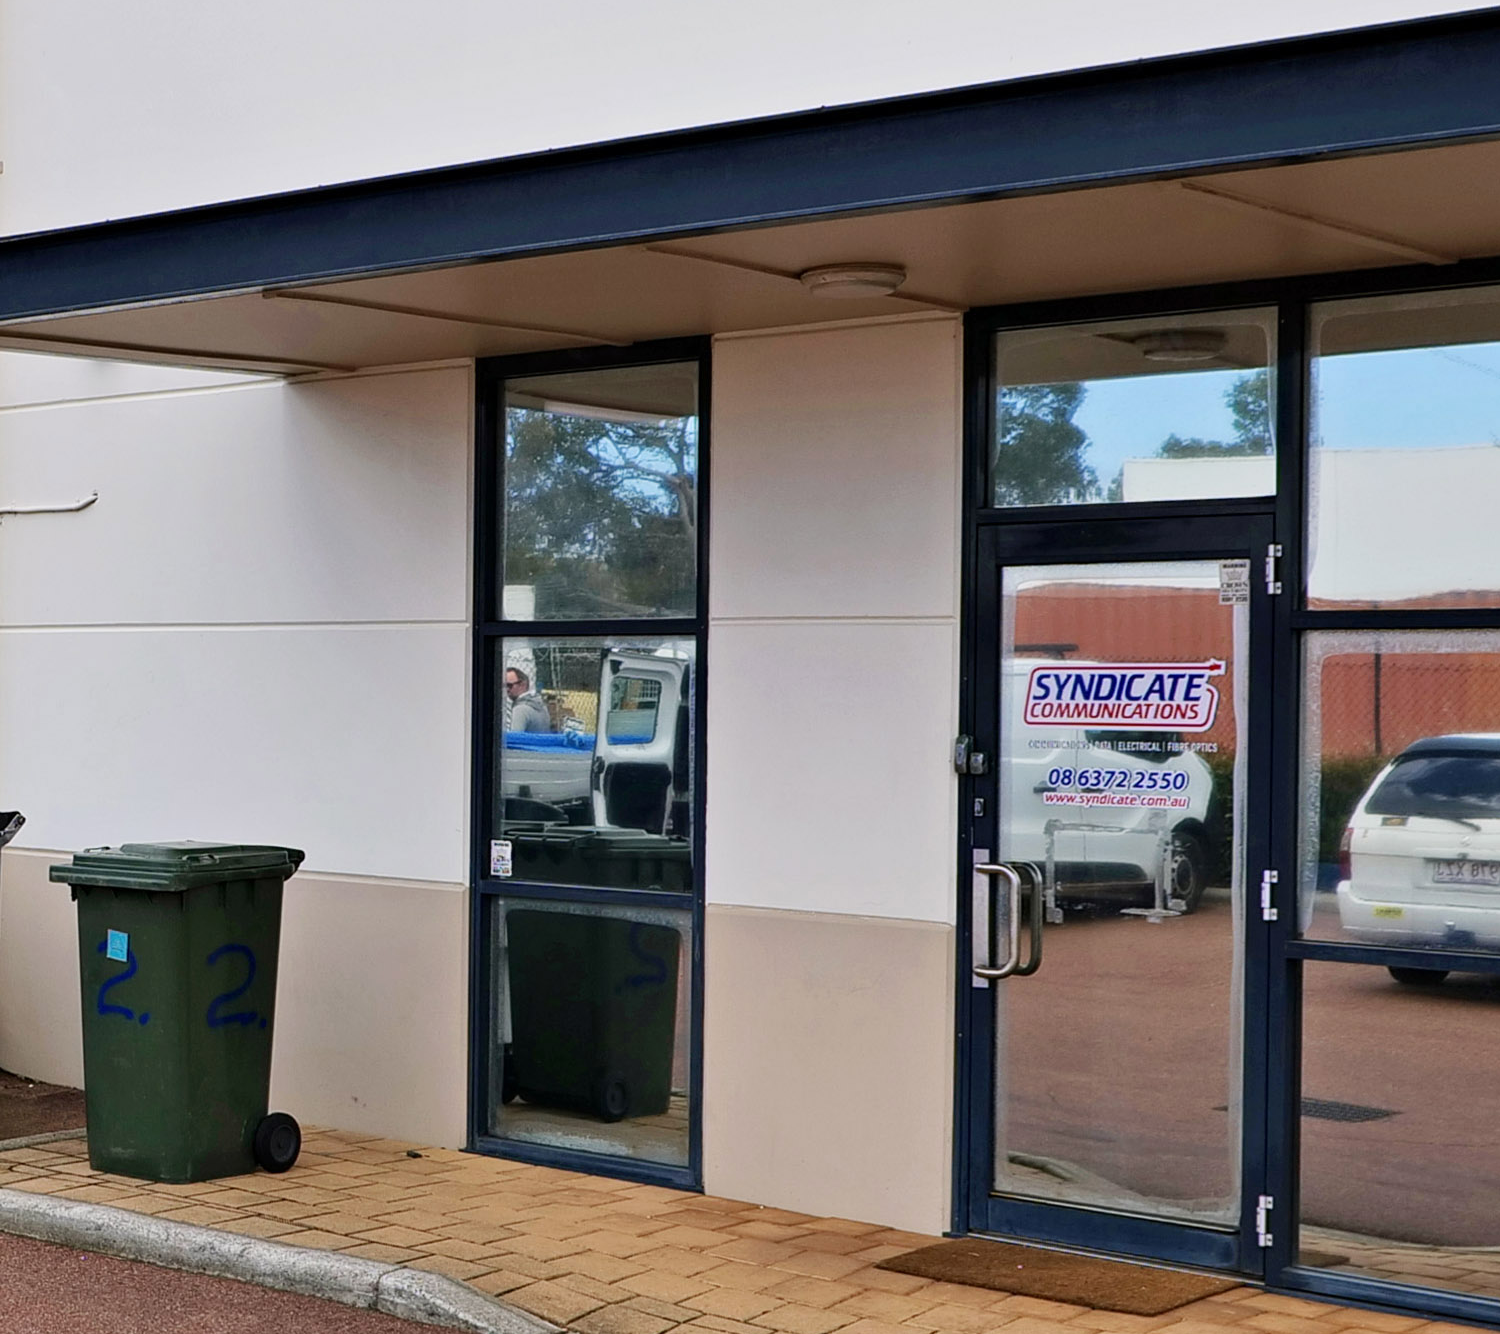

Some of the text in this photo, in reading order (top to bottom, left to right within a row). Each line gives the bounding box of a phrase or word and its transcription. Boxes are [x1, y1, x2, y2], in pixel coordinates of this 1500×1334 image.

[1032, 673, 1206, 702] SYNDICATE
[1030, 702, 1199, 720] COMMUNICATIONS
[1118, 740, 1162, 752] ELECTRICAL
[1167, 742, 1190, 752] FIBRE
[1191, 742, 1218, 753] OPTICS
[1048, 768, 1187, 790] 08 6372 2550
[1045, 793, 1187, 808] www.syndicate.com.au
